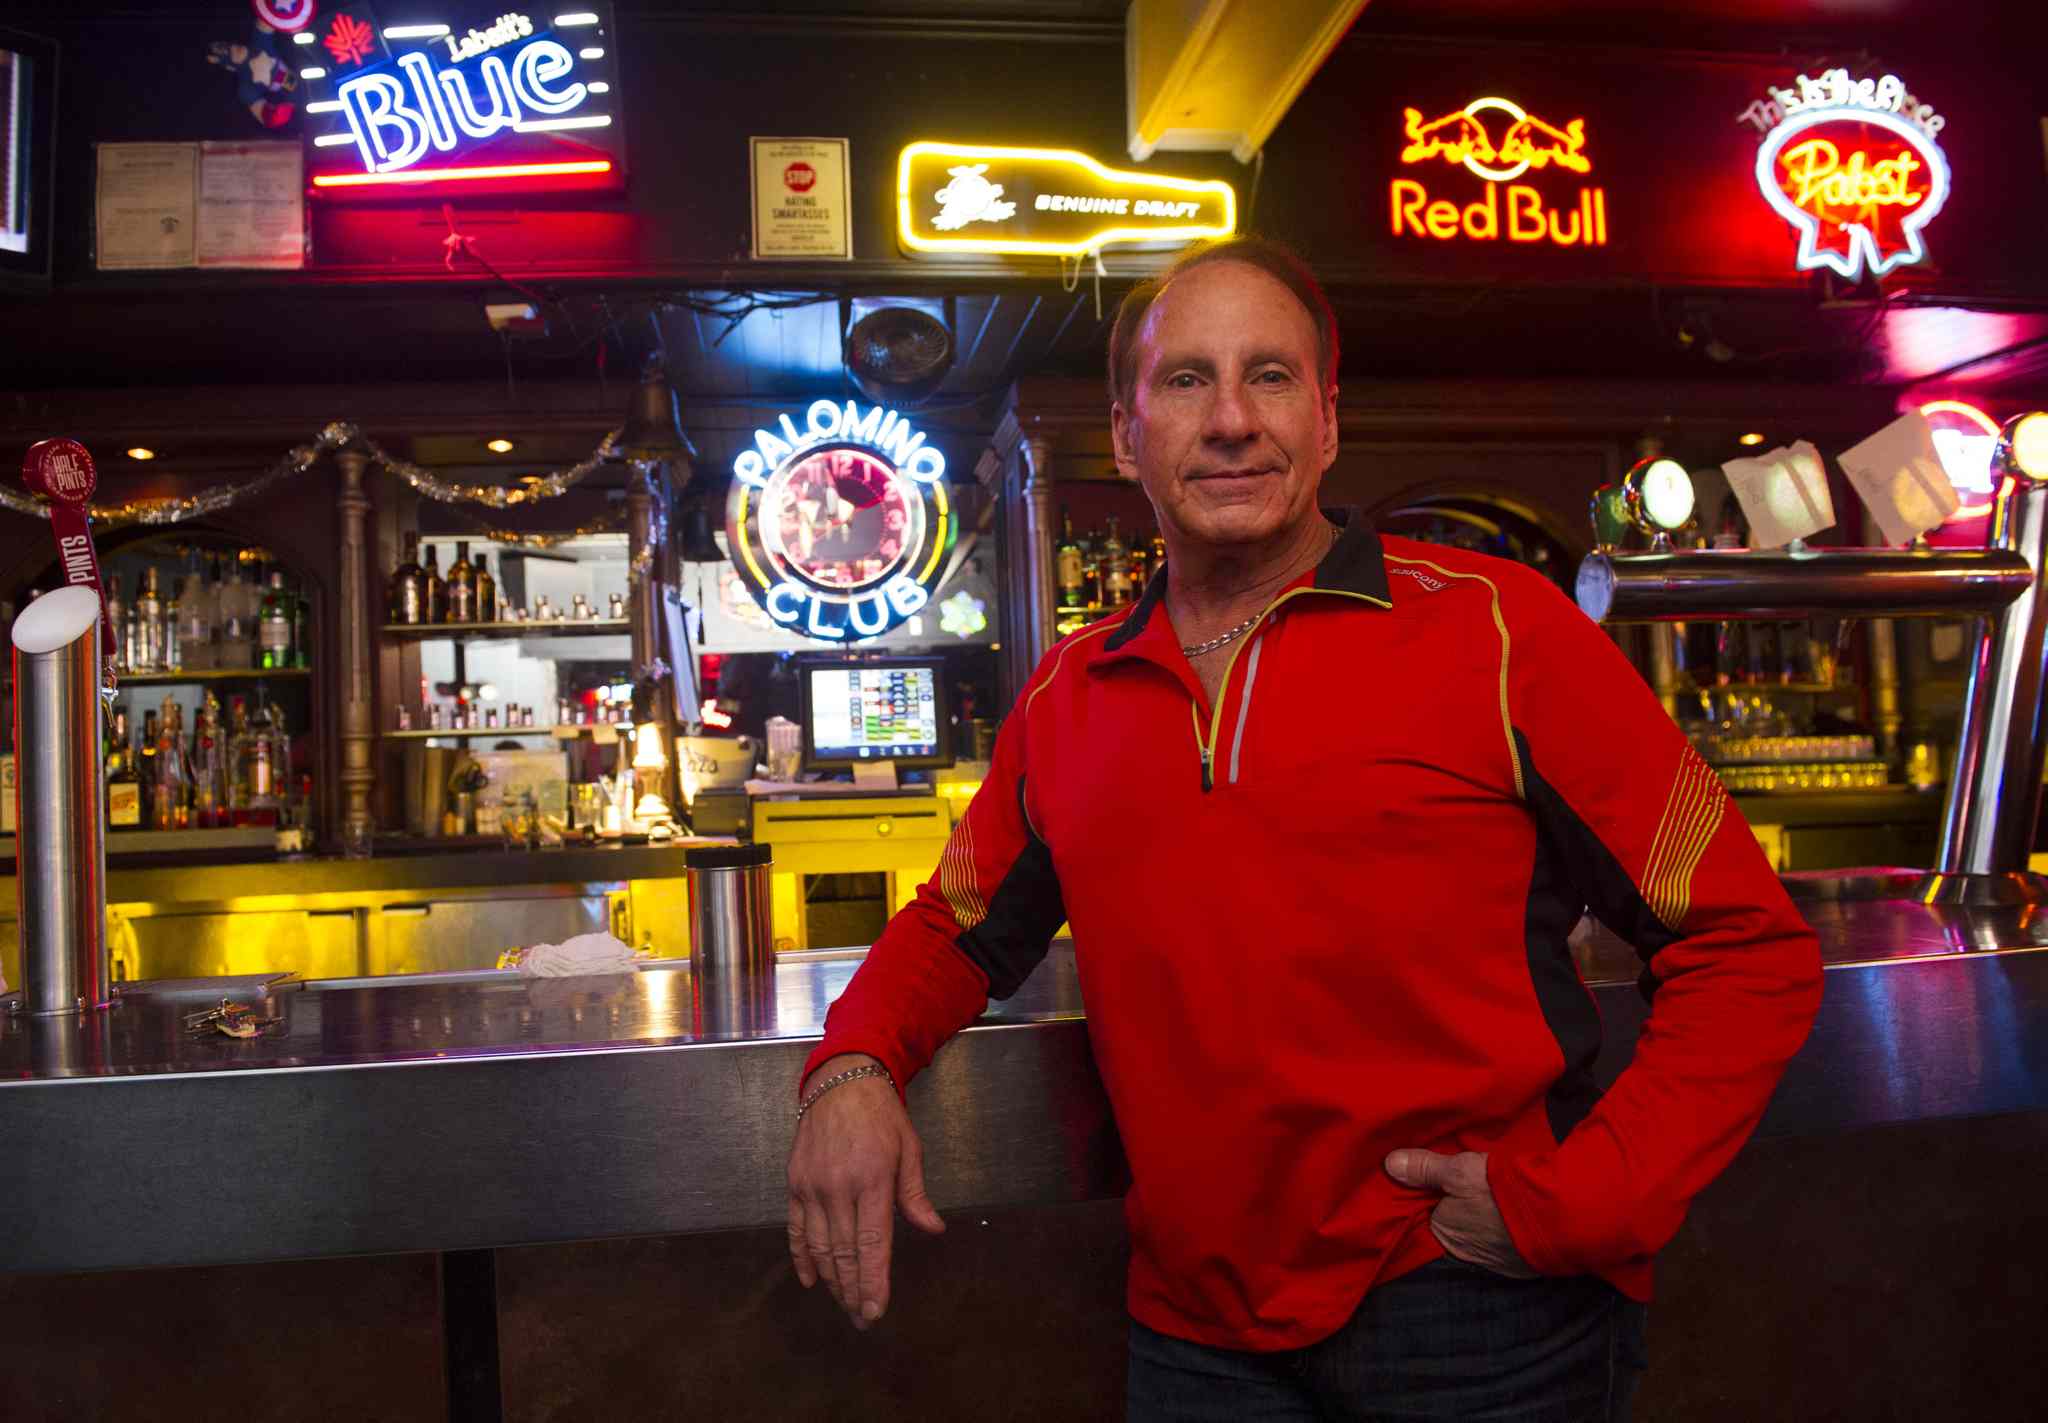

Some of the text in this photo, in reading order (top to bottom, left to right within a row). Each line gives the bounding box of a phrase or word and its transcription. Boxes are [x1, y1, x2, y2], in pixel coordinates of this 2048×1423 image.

[338, 40, 587, 173] Blue
[1781, 138, 1922, 207] Pabst
[1034, 194, 1201, 218] GENUINE DRAFT
[1390, 178, 1607, 245] Red Bull
[52, 453, 80, 473] HALF
[733, 399, 946, 489] PALOMINO
[56, 469, 87, 491] PINTS
[60, 534, 96, 584] PINTS
[765, 573, 929, 639] CLUB
